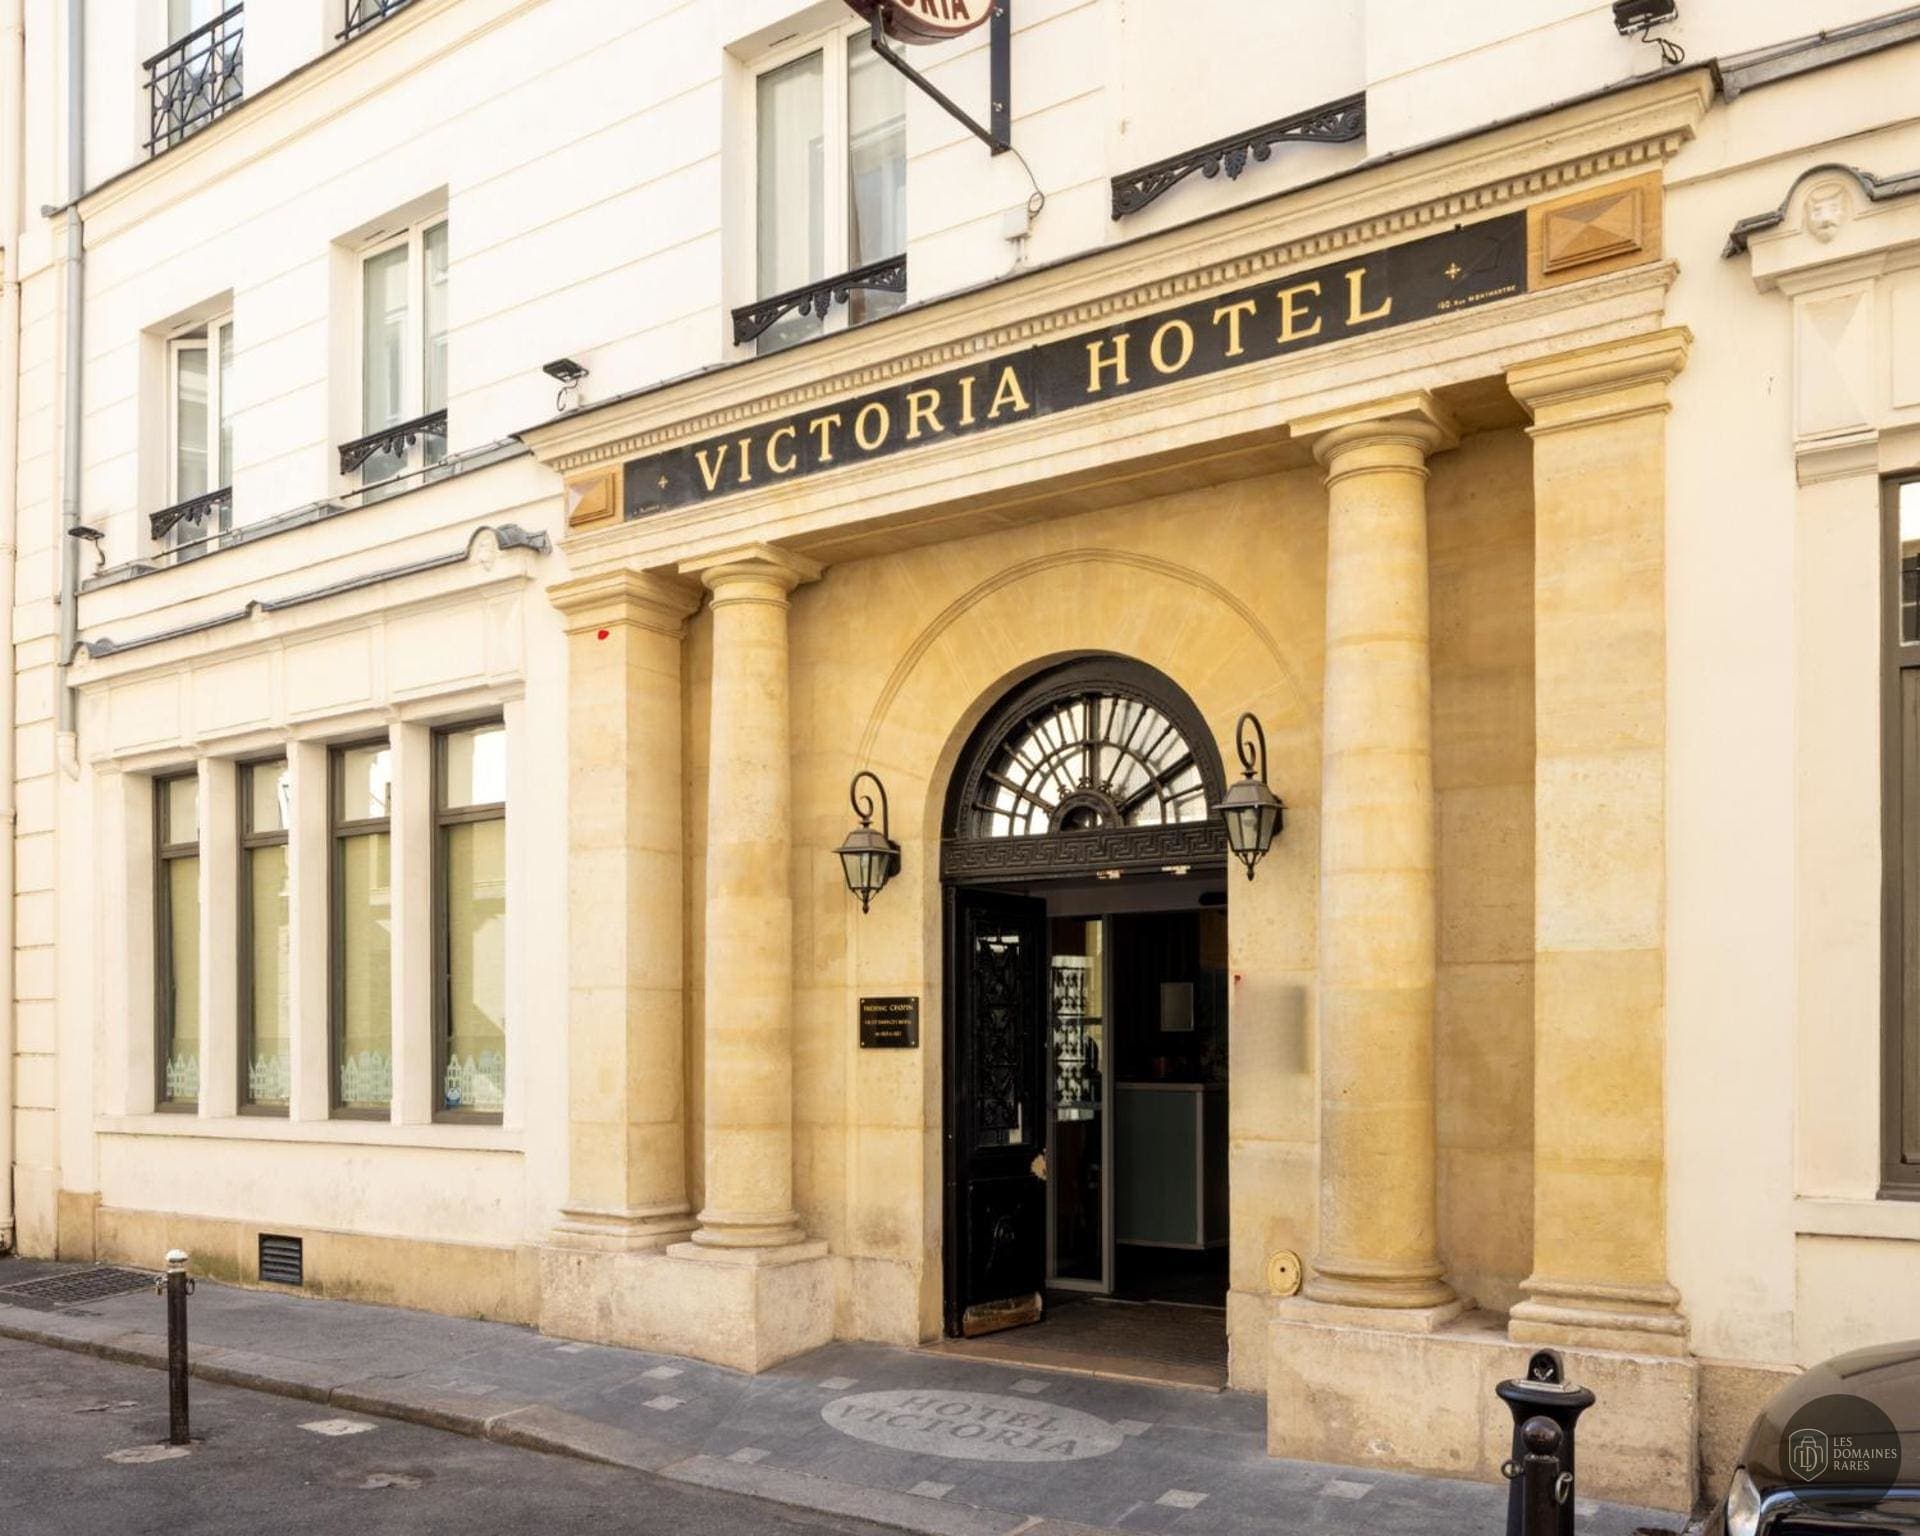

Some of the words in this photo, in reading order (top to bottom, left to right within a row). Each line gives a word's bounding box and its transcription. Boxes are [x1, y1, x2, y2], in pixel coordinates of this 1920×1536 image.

[694, 365, 1030, 491] VICTORIA
[1085, 267, 1393, 393] HOTEL
[840, 1404, 1078, 1456] VICTORIA
[897, 1396, 1058, 1432] HOTEL
